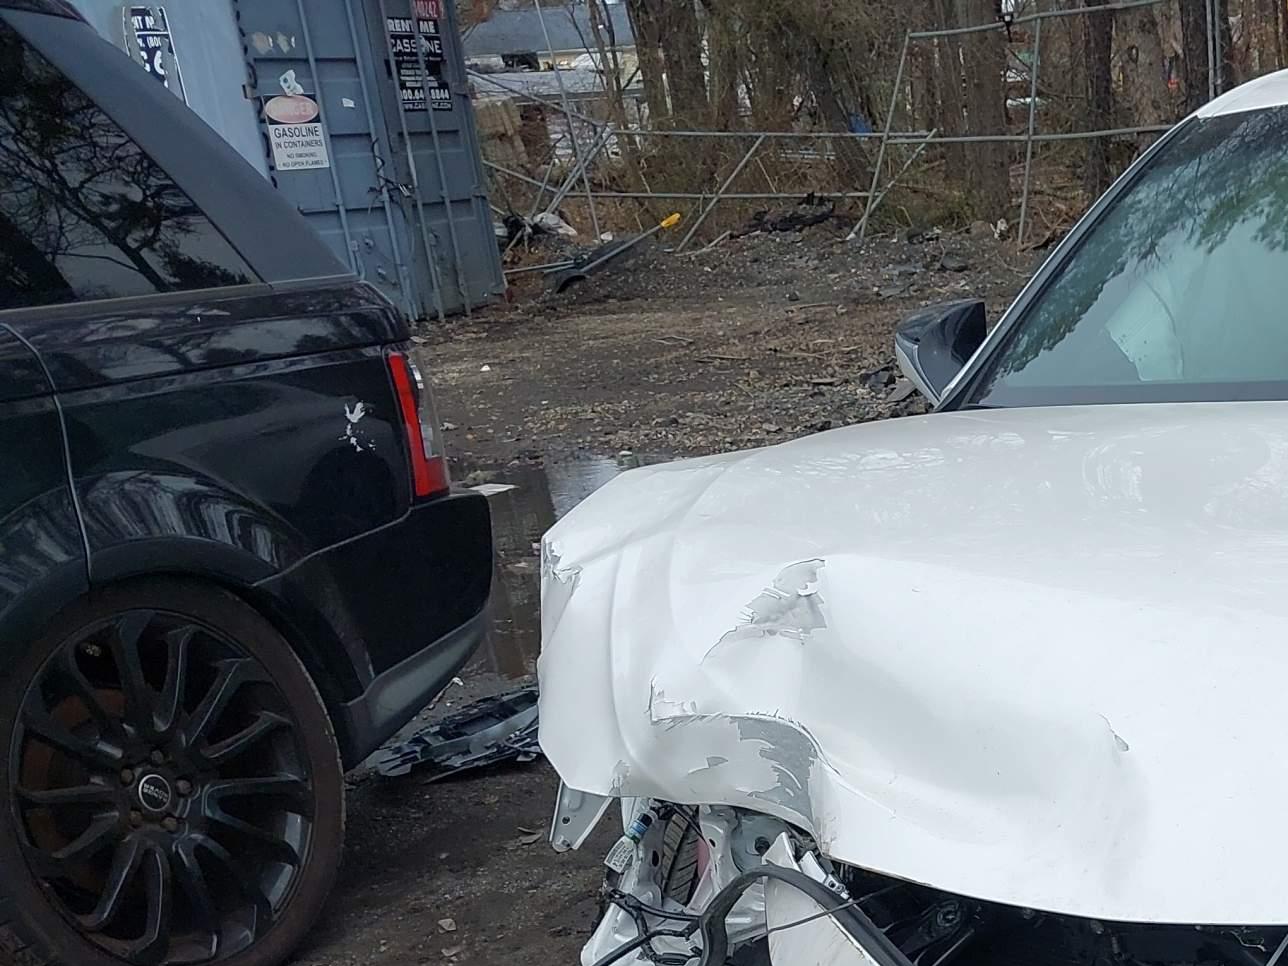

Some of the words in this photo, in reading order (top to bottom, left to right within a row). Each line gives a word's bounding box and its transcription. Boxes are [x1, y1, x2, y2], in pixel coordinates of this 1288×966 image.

[419, 20, 436, 33] ME
[274, 126, 320, 138] GASOLINE
[275, 141, 283, 149] IN
[283, 139, 323, 149] CONTAINERS
